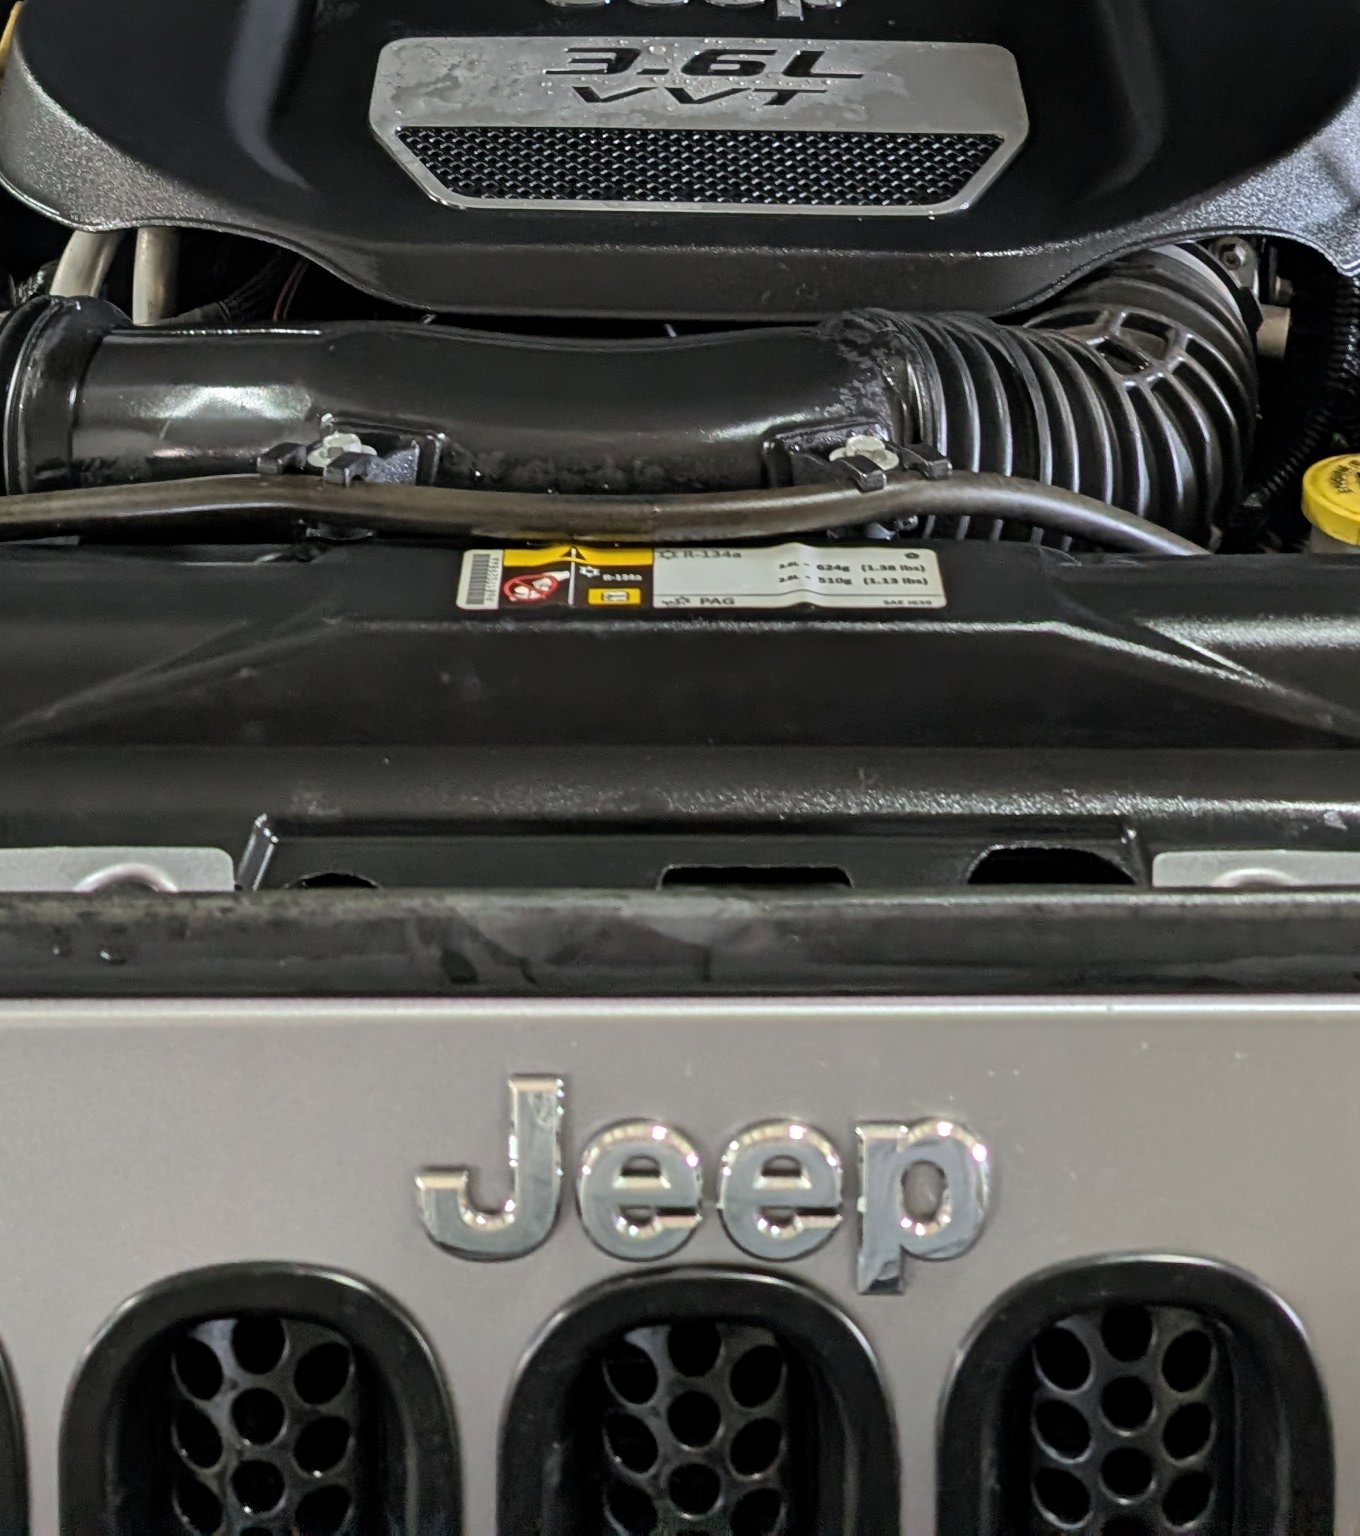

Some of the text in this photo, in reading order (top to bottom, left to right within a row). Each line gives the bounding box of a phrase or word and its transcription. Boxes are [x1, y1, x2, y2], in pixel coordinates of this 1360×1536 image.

[545, 47, 864, 80] 3.6L
[570, 85, 827, 107] VVT
[682, 550, 742, 560] R-134a
[816, 564, 851, 572] 624g
[861, 564, 897, 572] (1.38
[899, 564, 926, 572] lbs)
[818, 577, 853, 585] 510g
[863, 577, 899, 585] (1.13
[902, 577, 928, 585] lbs)
[700, 597, 736, 606] PAG
[415, 1073, 991, 1295] Jeep
